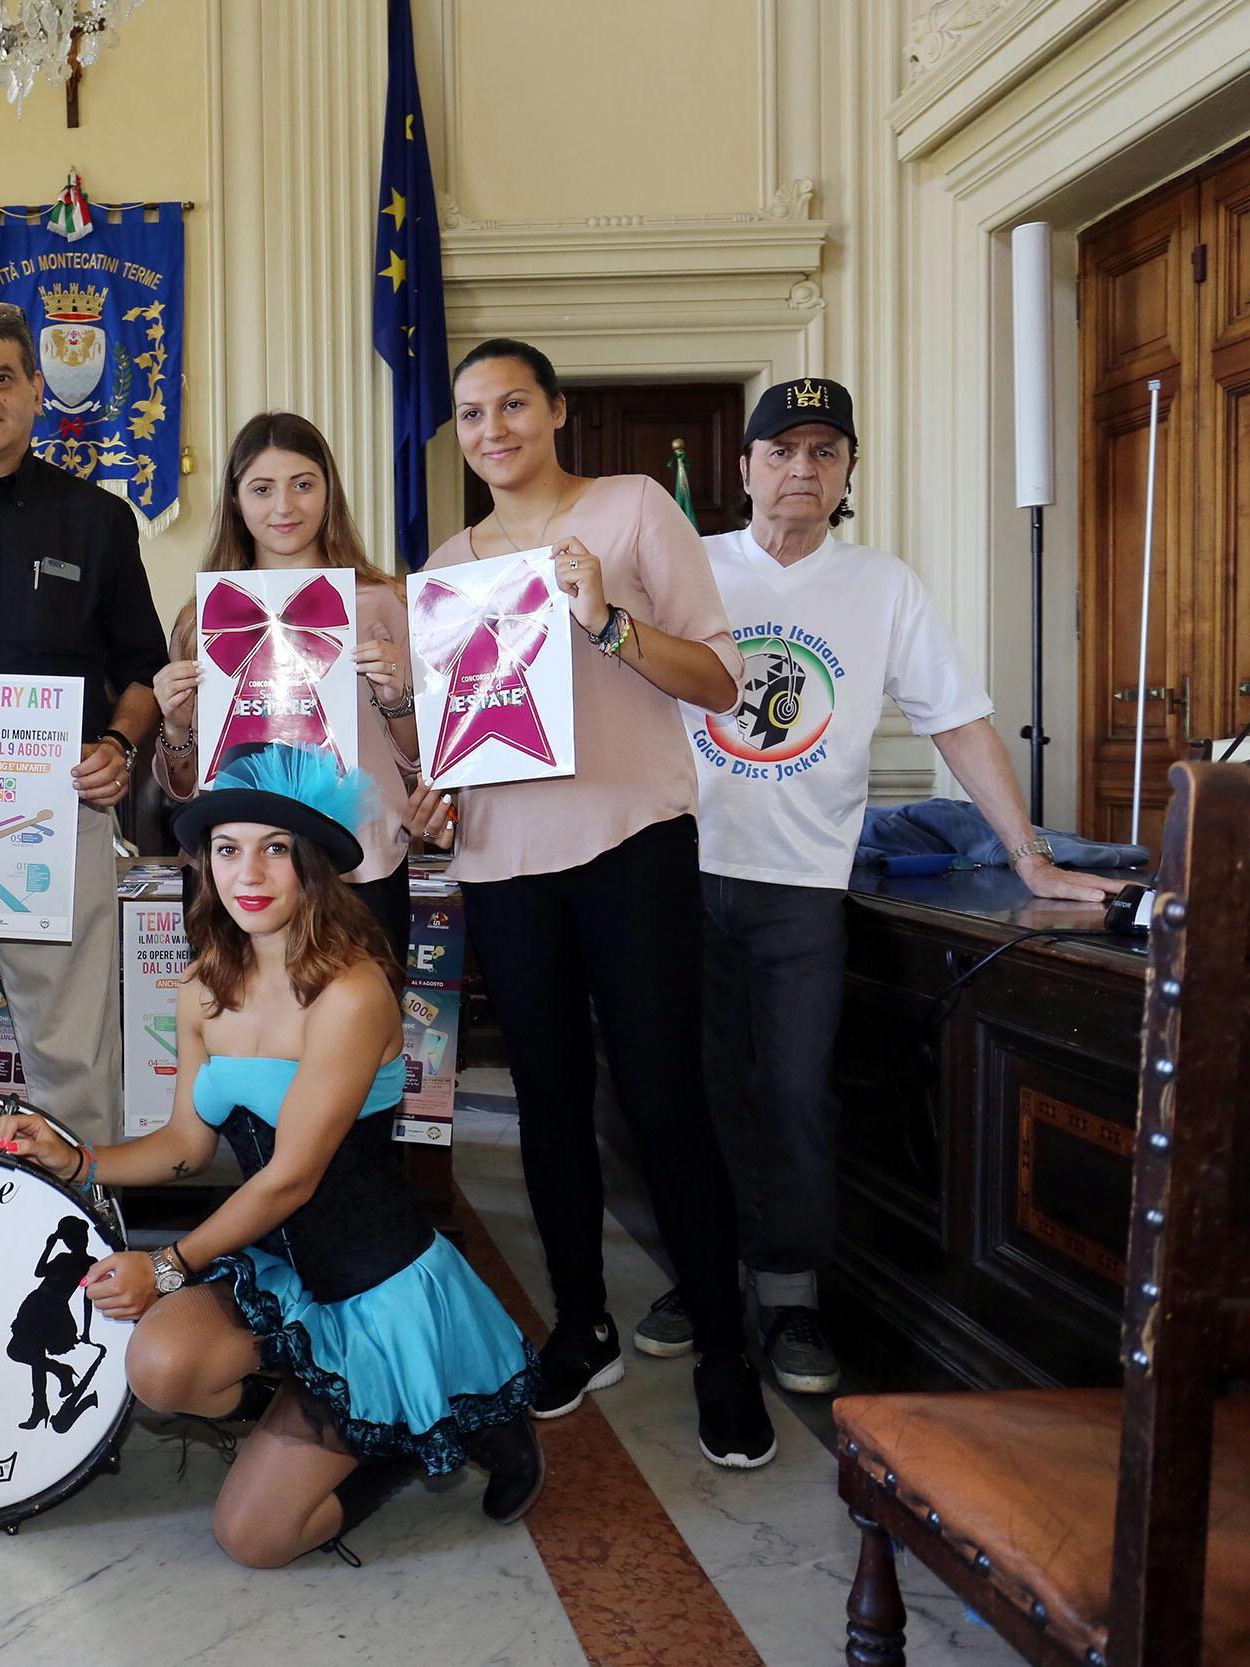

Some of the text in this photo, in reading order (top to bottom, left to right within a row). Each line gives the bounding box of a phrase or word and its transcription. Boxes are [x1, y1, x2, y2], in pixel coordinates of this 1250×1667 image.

[21, 260, 35, 276] DI
[38, 252, 119, 274] MONTECATINI
[122, 262, 163, 290] TERME
[797, 398, 821, 407] 54
[732, 622, 846, 679] onale Italiana
[28, 687, 64, 710] ART
[2, 729, 10, 739] DI
[12, 729, 69, 742] MONTECATINI
[8, 742, 15, 756] 9
[18, 743, 62, 758] AGOSTO
[693, 729, 727, 768] Calcio
[731, 760, 769, 780] Disc
[16, 764, 48, 773] UN'ARTE
[11, 834, 21, 843] 05
[137, 912, 182, 931] TEMP
[139, 936, 145, 944] IL
[146, 934, 170, 944] MOCA
[172, 936, 181, 944] VA
[137, 951, 148, 960] 26
[150, 951, 174, 960] OPERE
[142, 962, 162, 974] DAL
[166, 962, 172, 974] 9
